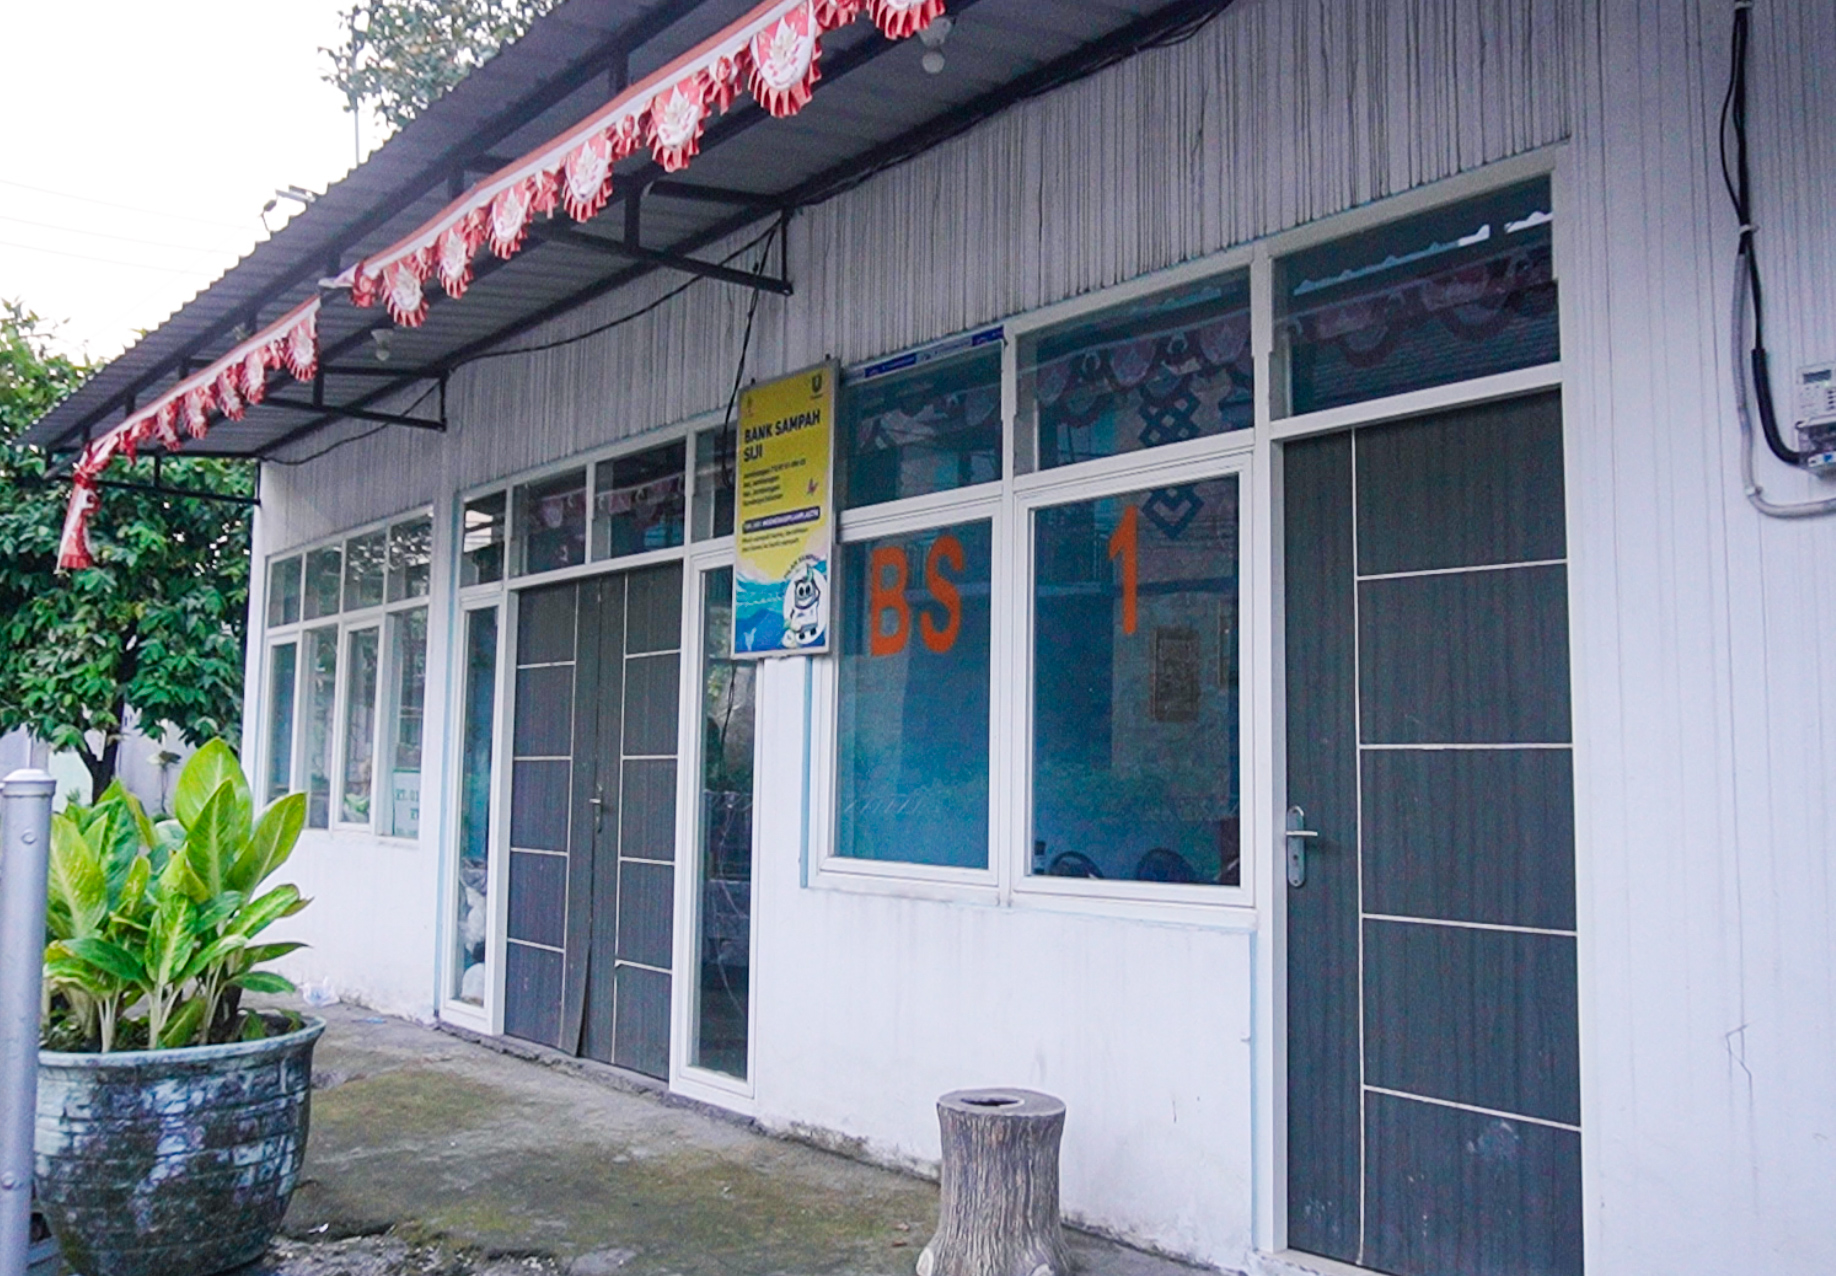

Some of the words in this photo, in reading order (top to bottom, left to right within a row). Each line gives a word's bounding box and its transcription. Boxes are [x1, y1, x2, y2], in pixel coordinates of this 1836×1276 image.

[744, 423, 773, 443] BANK
[775, 408, 821, 435] SAMPAH
[870, 534, 965, 657] BS
[1108, 504, 1138, 635] 1
